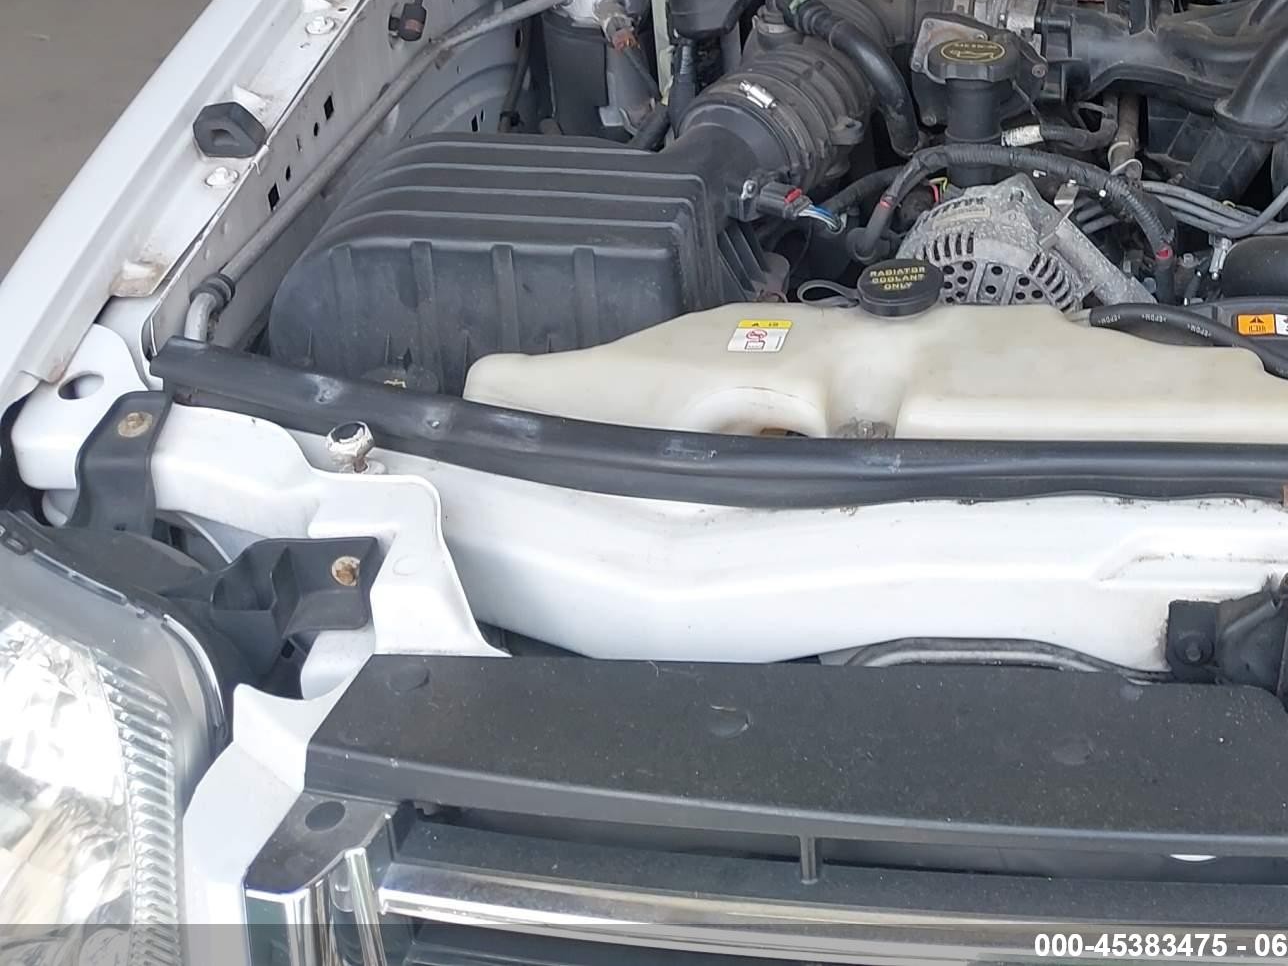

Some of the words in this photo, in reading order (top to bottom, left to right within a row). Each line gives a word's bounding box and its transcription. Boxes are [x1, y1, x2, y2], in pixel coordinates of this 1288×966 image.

[869, 266, 926, 278] RADIATOR
[871, 274, 925, 284] COOLANT
[884, 282, 913, 291] ONLY
